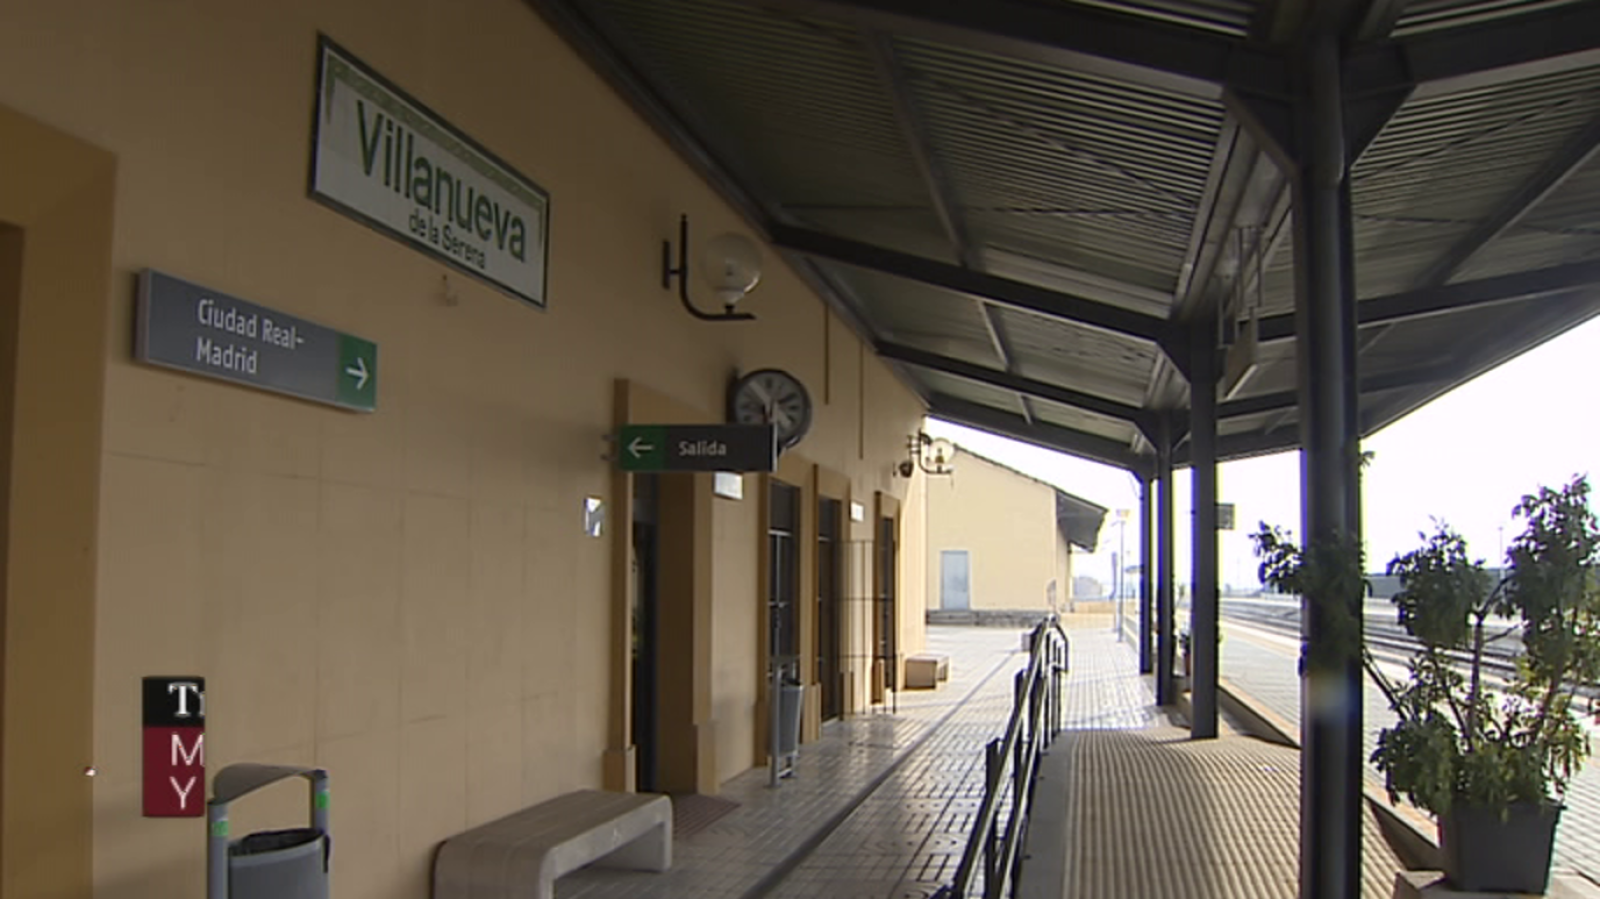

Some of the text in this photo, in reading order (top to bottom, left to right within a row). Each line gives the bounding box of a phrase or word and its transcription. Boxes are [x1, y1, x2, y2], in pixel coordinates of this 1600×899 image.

[357, 99, 526, 264] Villanueva
[409, 207, 486, 270] de la Serena
[197, 299, 305, 350] Ciudad Real-
[195, 335, 258, 375] Madrid
[678, 440, 727, 457] Salida
